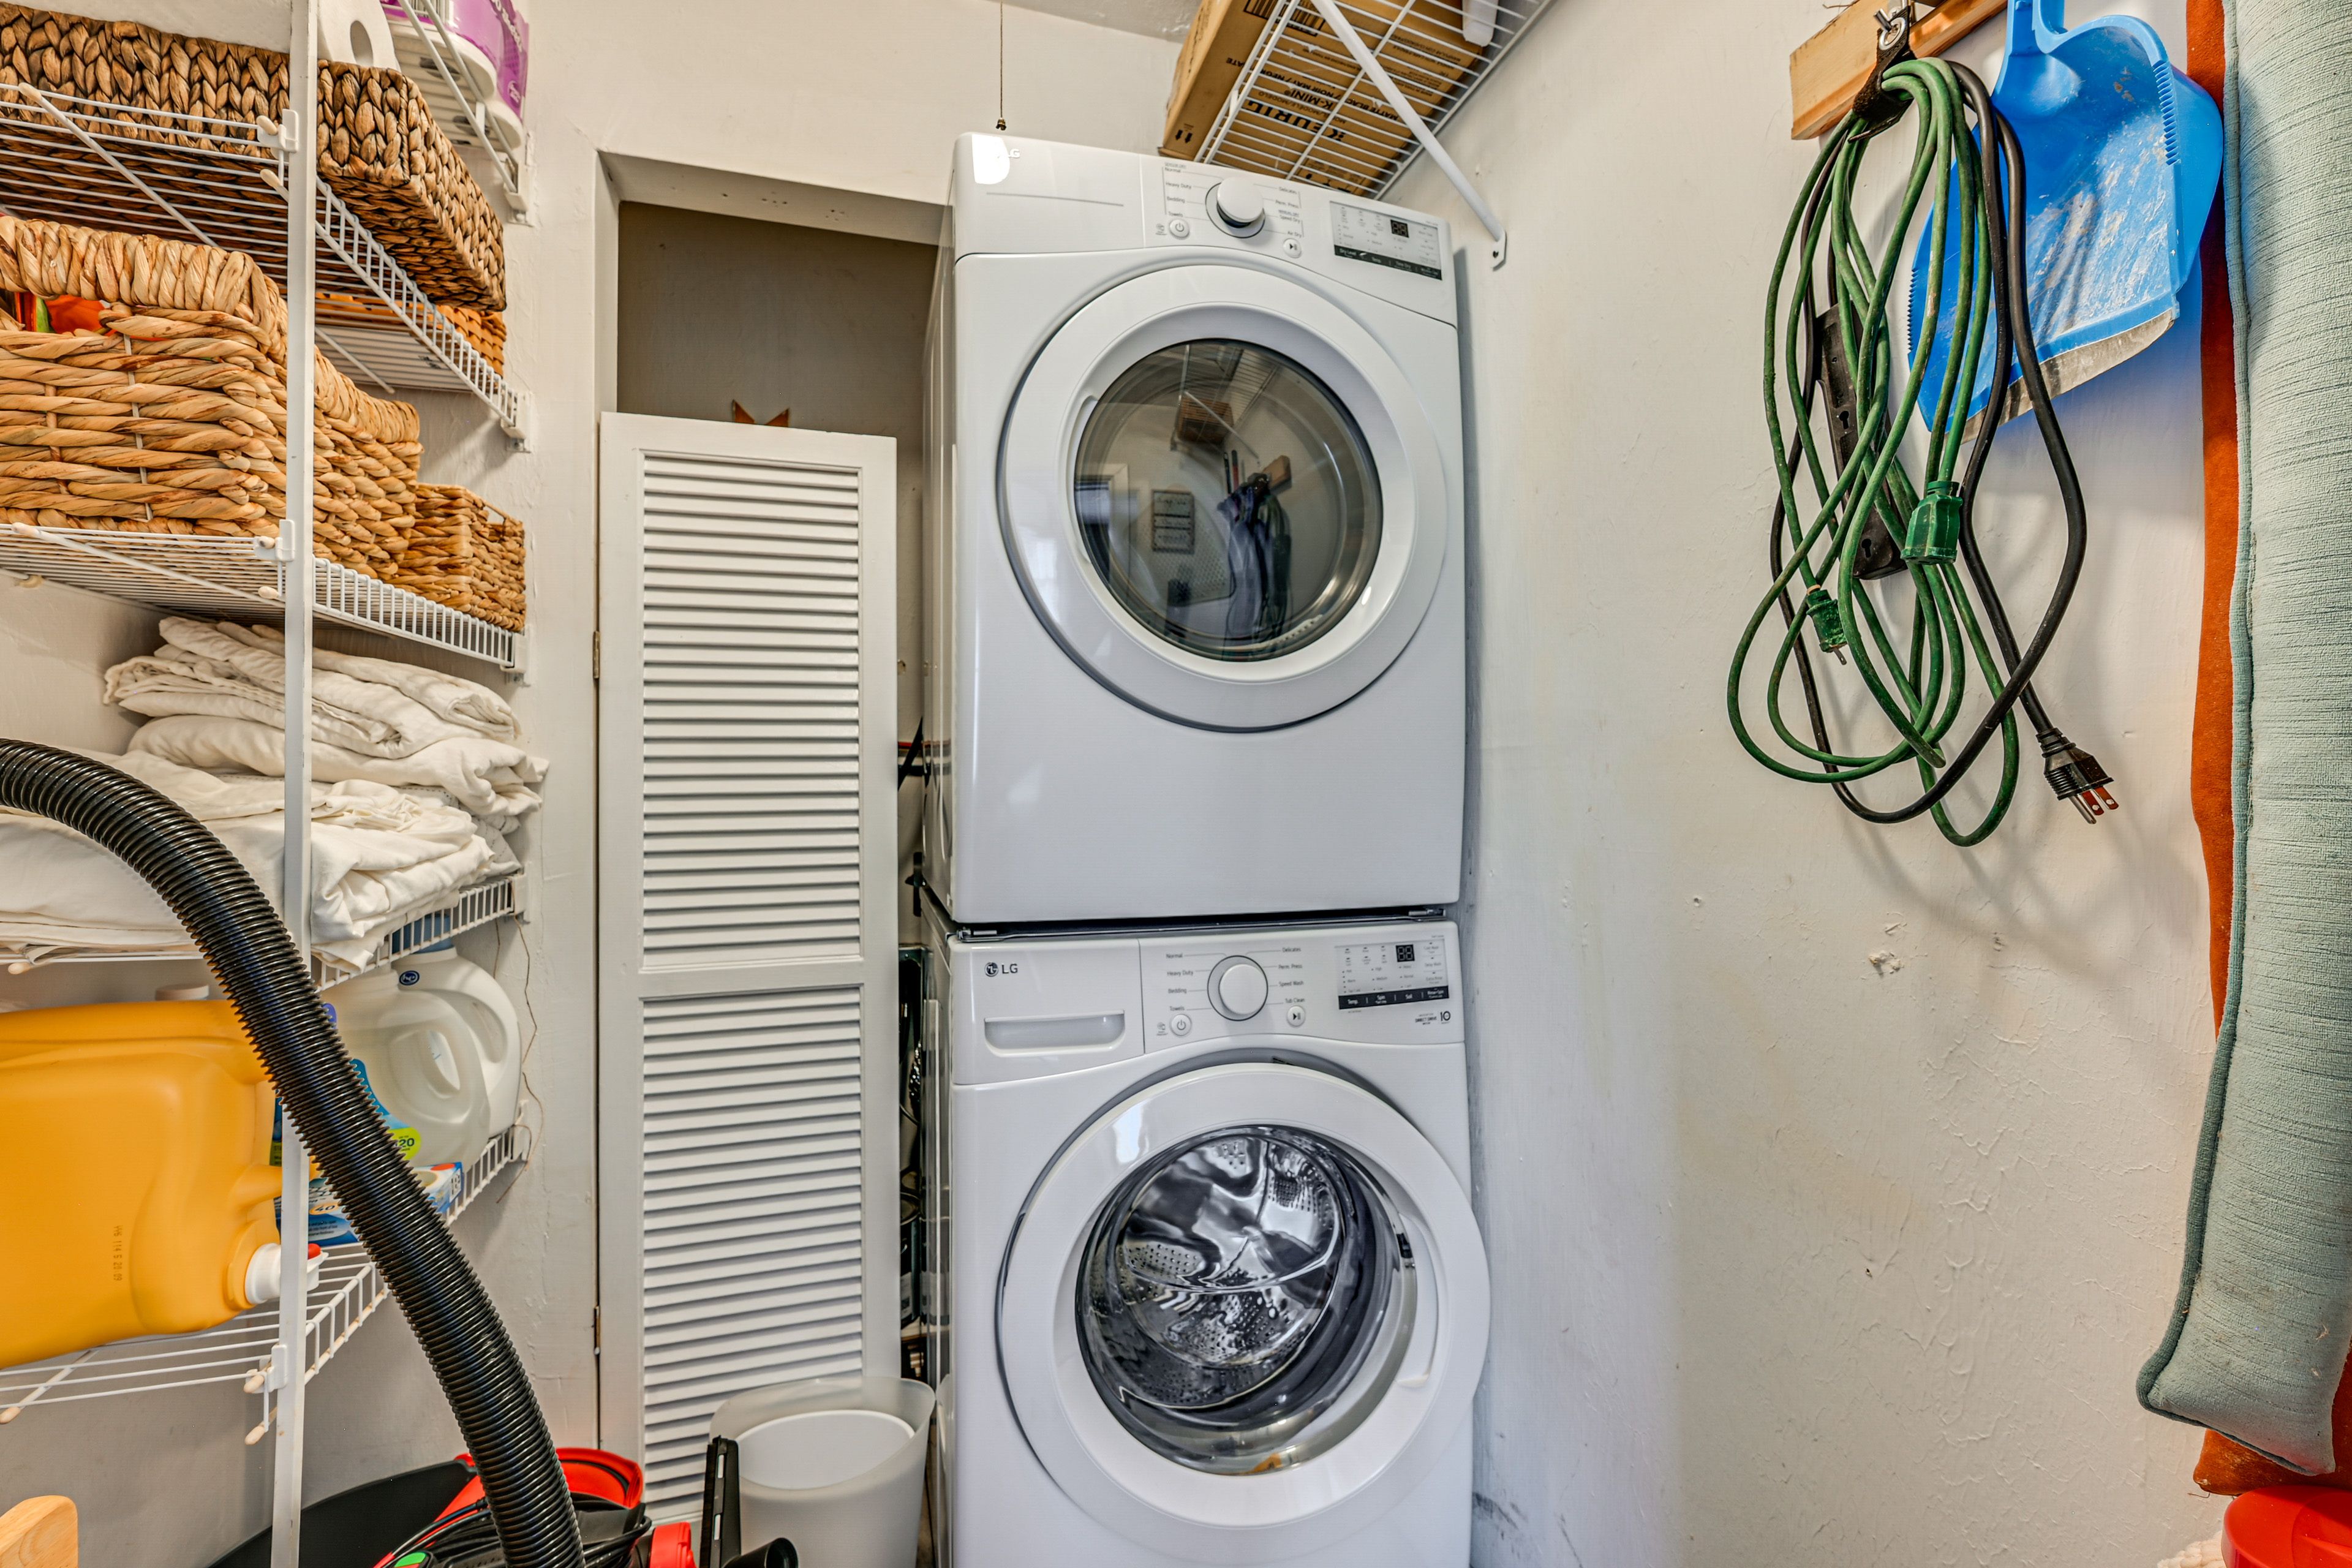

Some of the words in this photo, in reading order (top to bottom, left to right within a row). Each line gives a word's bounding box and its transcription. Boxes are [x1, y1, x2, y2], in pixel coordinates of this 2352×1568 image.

[1294, 80, 1311, 90] MAT
[1312, 85, 1334, 97] NOIR
[1345, 98, 1370, 111] BLAC
[1370, 105, 1398, 121] MATTE
[1242, 100, 1346, 141] KEURIG
[1001, 963, 1018, 974] LG
[394, 1137, 415, 1148] 20
